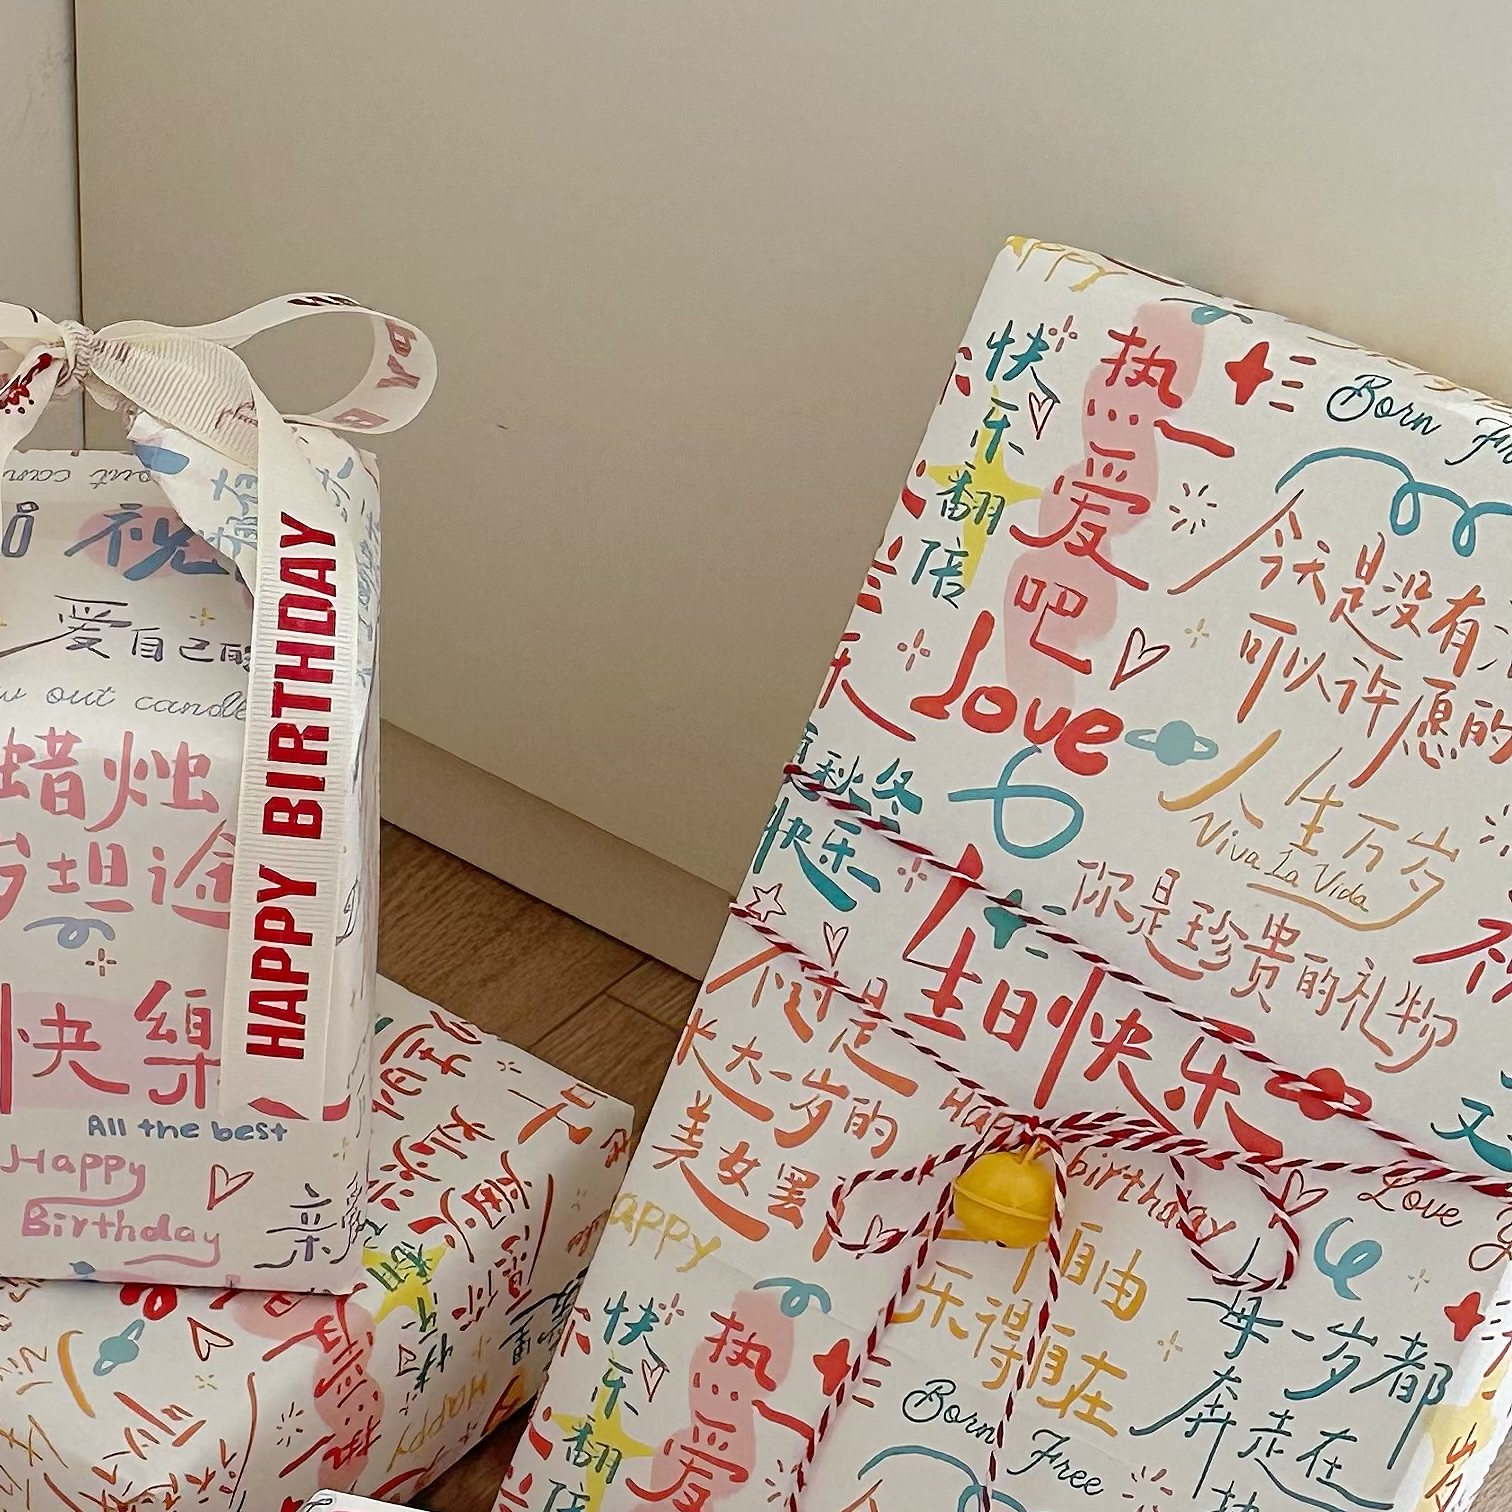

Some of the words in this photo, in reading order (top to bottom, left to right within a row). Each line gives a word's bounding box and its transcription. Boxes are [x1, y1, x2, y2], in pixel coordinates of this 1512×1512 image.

[1326, 373, 1442, 436] Born
[910, 320, 1061, 610] 快乐翻倍
[1008, 325, 1237, 676] 热爱吧
[1167, 488, 1512, 679] 今天是没有
[45, 684, 118, 709] out
[134, 690, 249, 722] candle
[262, 511, 338, 840] BIRTHDAY
[1158, 728, 1462, 931] 人生万岁
[1189, 811, 1261, 872] Viva
[1302, 862, 1372, 914] Vida
[245, 863, 318, 1060] HAPPY
[1072, 859, 1459, 1074] 你是珍贵的礼物
[0, 1144, 148, 1206] Happy
[87, 1113, 126, 1137] All
[138, 1117, 199, 1139] the
[211, 1119, 287, 1142] best
[22, 1205, 221, 1268] Birthday
[608, 1192, 723, 1274] appy
[901, 1379, 996, 1446] Born
[1006, 1428, 1106, 1497] Free
